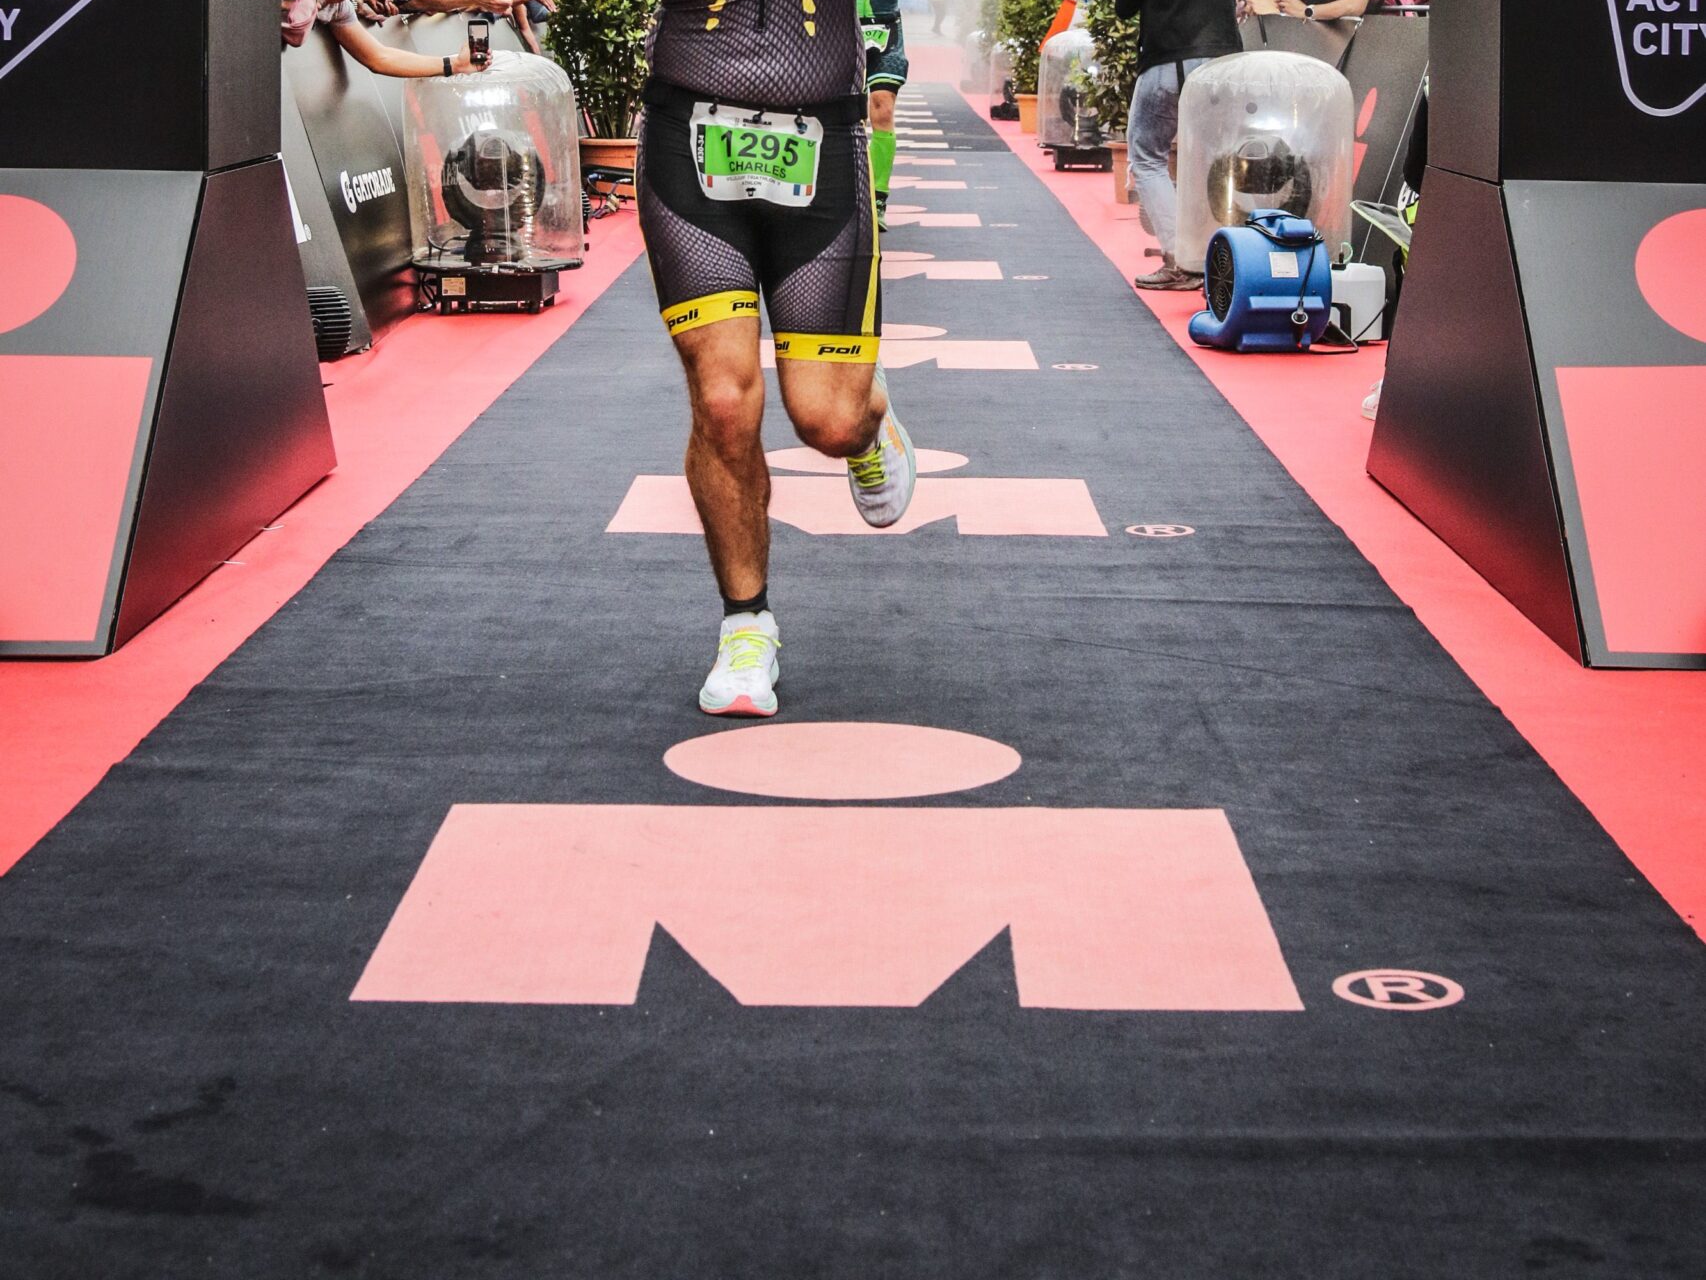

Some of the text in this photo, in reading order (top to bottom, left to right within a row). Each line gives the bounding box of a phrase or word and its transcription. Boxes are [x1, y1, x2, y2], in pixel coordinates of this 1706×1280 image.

[720, 129, 799, 167] 1295
[728, 160, 787, 179] CHARLES
[352, 166, 396, 204] GATORADE
[818, 345, 862, 356] poli
